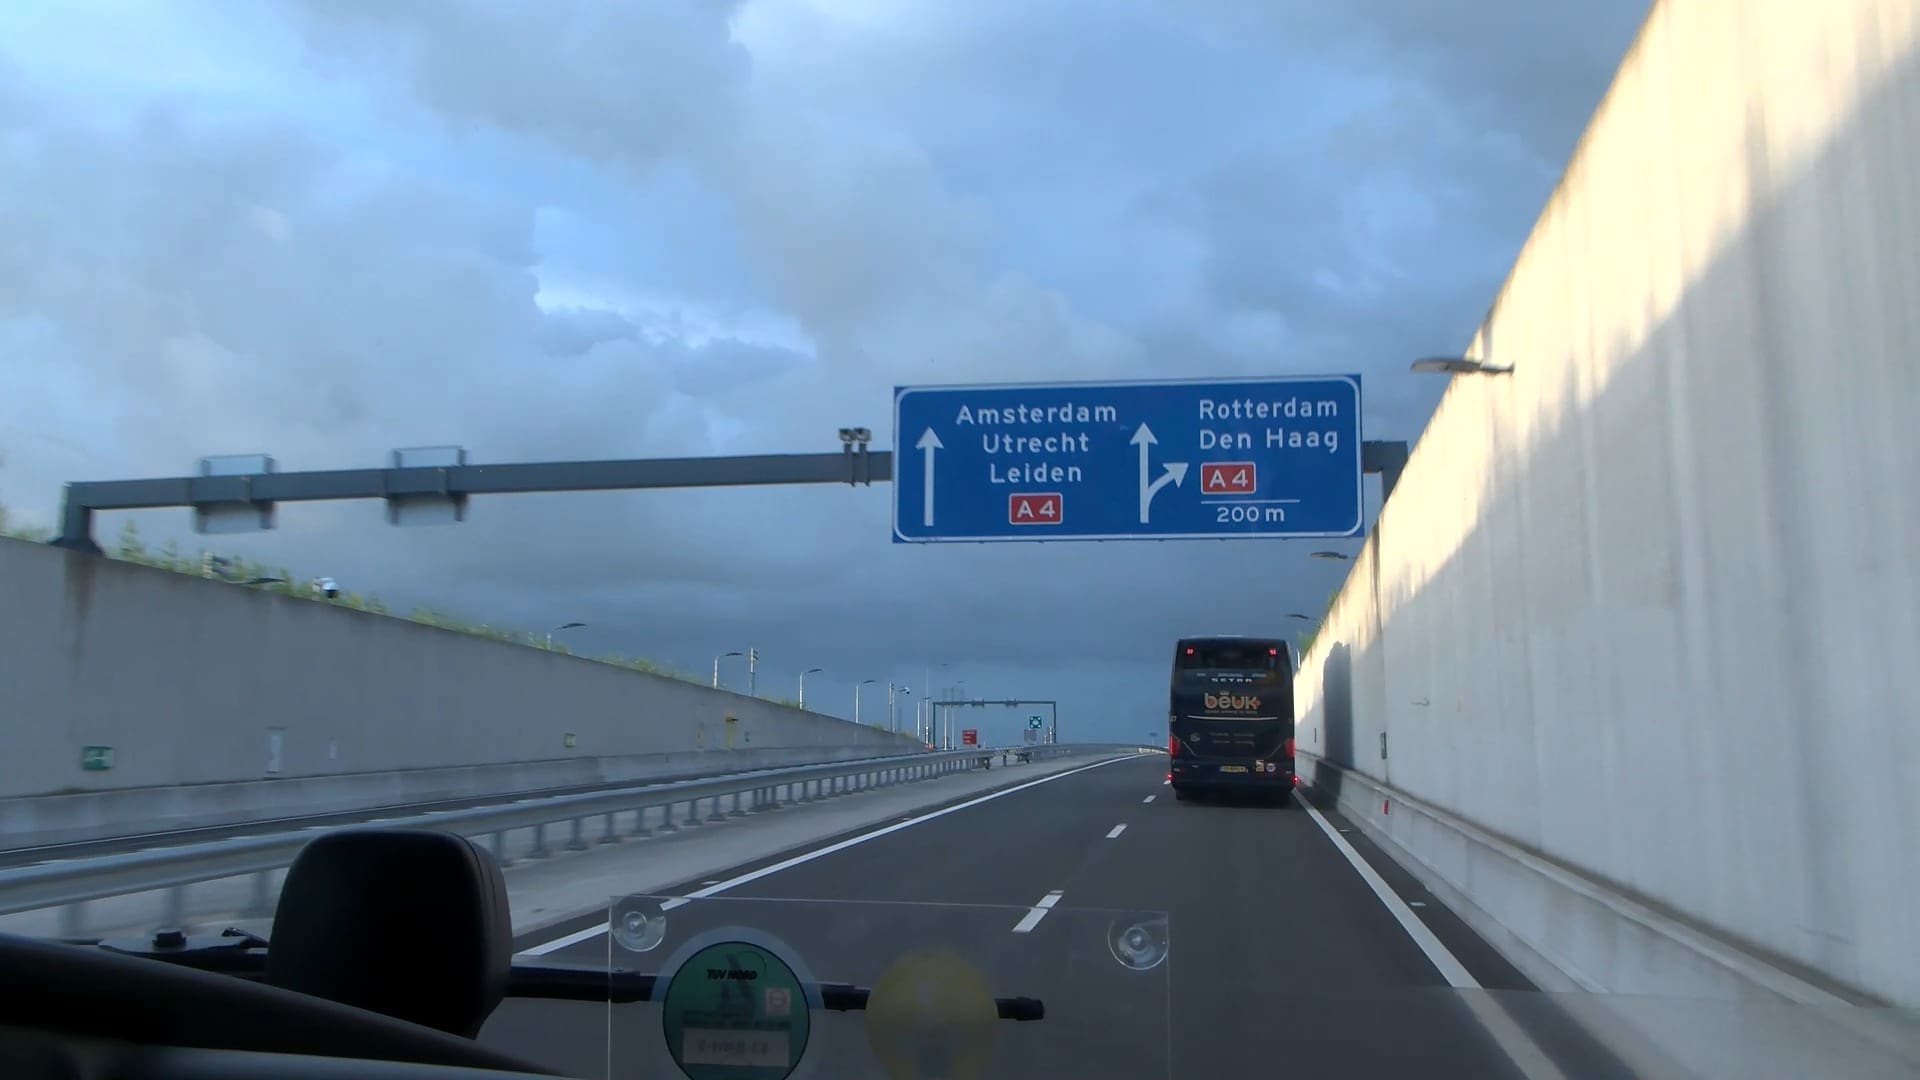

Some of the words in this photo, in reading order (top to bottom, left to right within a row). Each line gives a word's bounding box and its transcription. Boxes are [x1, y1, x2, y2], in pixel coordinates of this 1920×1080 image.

[956, 402, 1117, 425] Amsterdam
[1199, 397, 1338, 420] Rotterdam
[983, 432, 1089, 453] Utrecht
[1199, 429, 1251, 449] Den
[1266, 427, 1338, 453] Haag
[990, 462, 1082, 483] Leiden
[1209, 469, 1248, 488] A4
[1017, 500, 1056, 518] A4
[1216, 507, 1260, 523] 200
[1265, 507, 1285, 522] m
